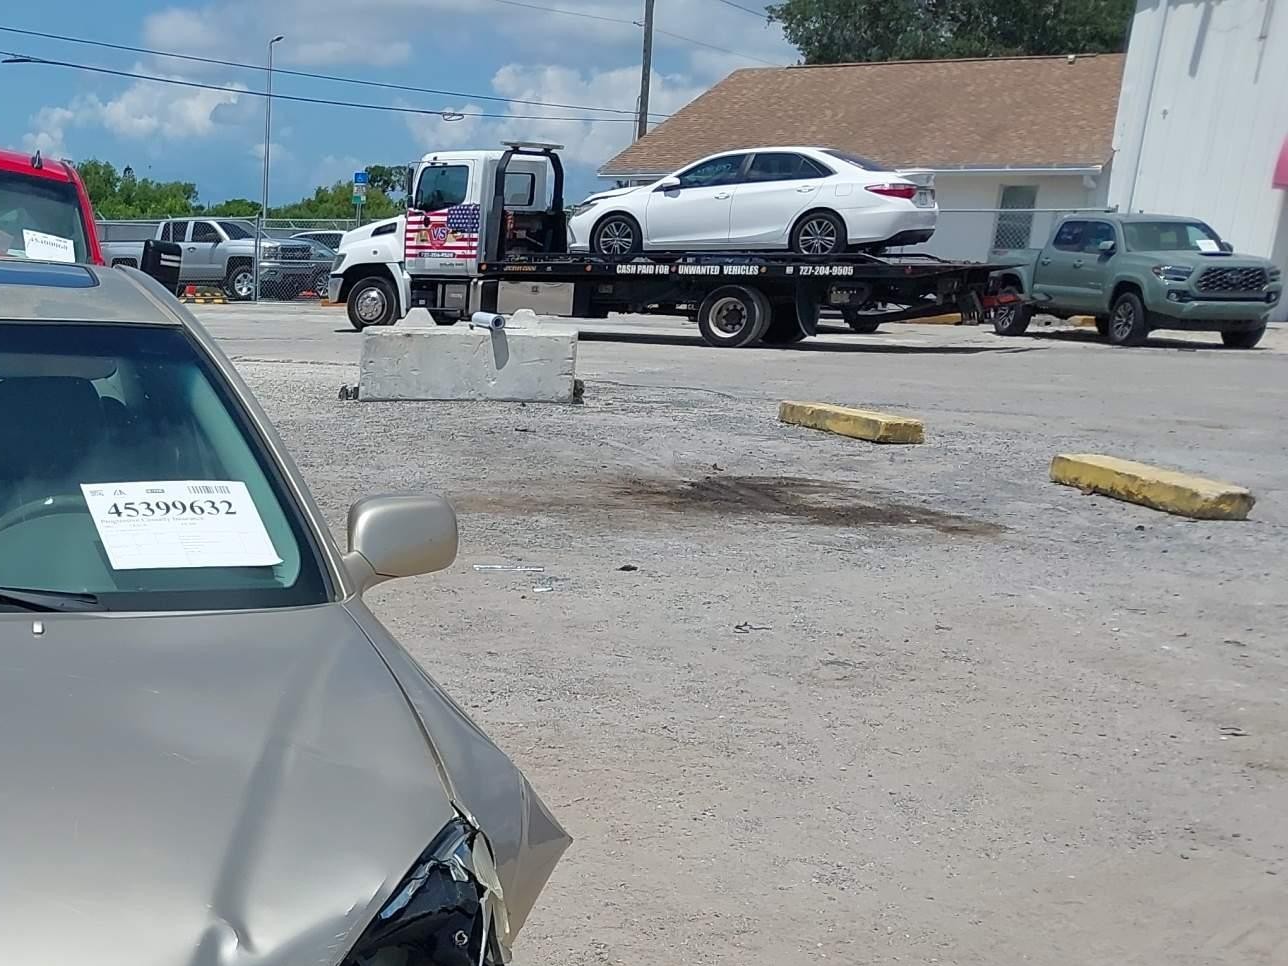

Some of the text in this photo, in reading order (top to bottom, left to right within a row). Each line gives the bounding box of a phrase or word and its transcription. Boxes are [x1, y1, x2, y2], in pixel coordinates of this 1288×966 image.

[431, 227, 448, 241] VS
[616, 264, 759, 275] CASH PAID FOR UNWANTED VEHICLES
[799, 266, 854, 276] 727-204-9505
[107, 499, 237, 518] 45399632
